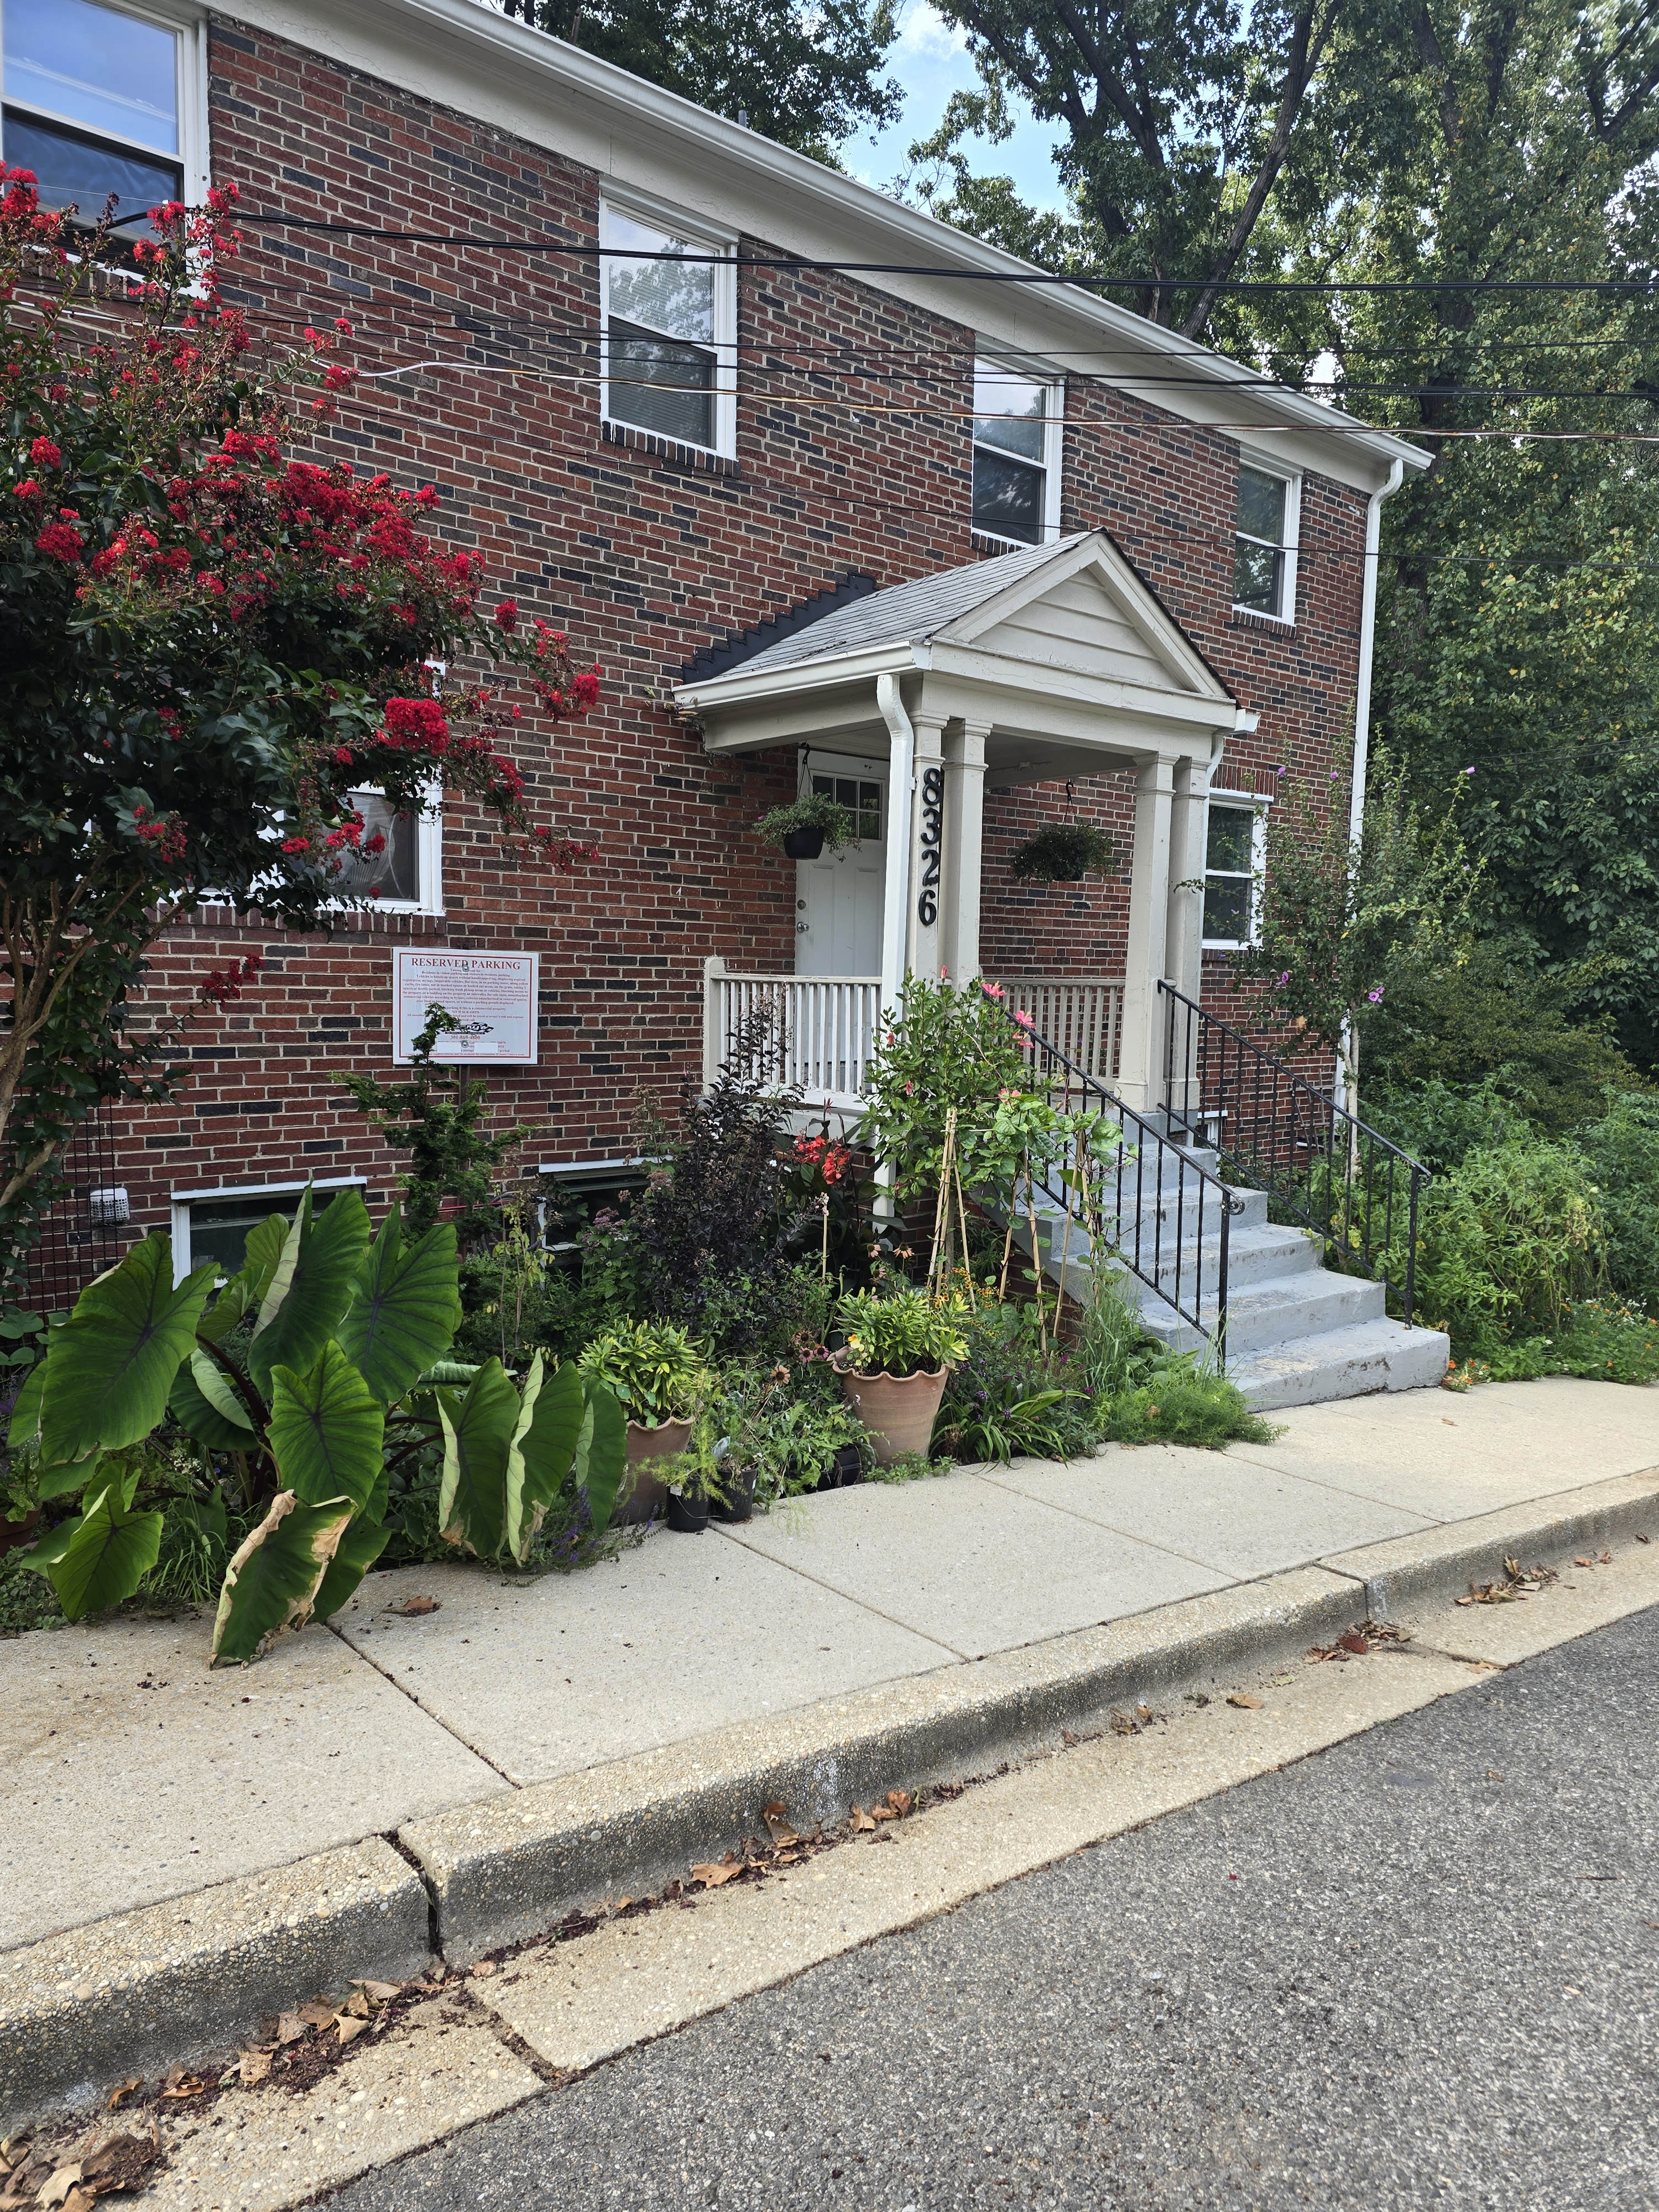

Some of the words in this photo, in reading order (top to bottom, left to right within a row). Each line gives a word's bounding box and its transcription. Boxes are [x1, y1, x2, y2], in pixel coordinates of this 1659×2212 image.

[919, 768, 942, 926] 8326
[411, 958, 468, 968] RESERVED
[472, 960, 520, 970] PARKING
